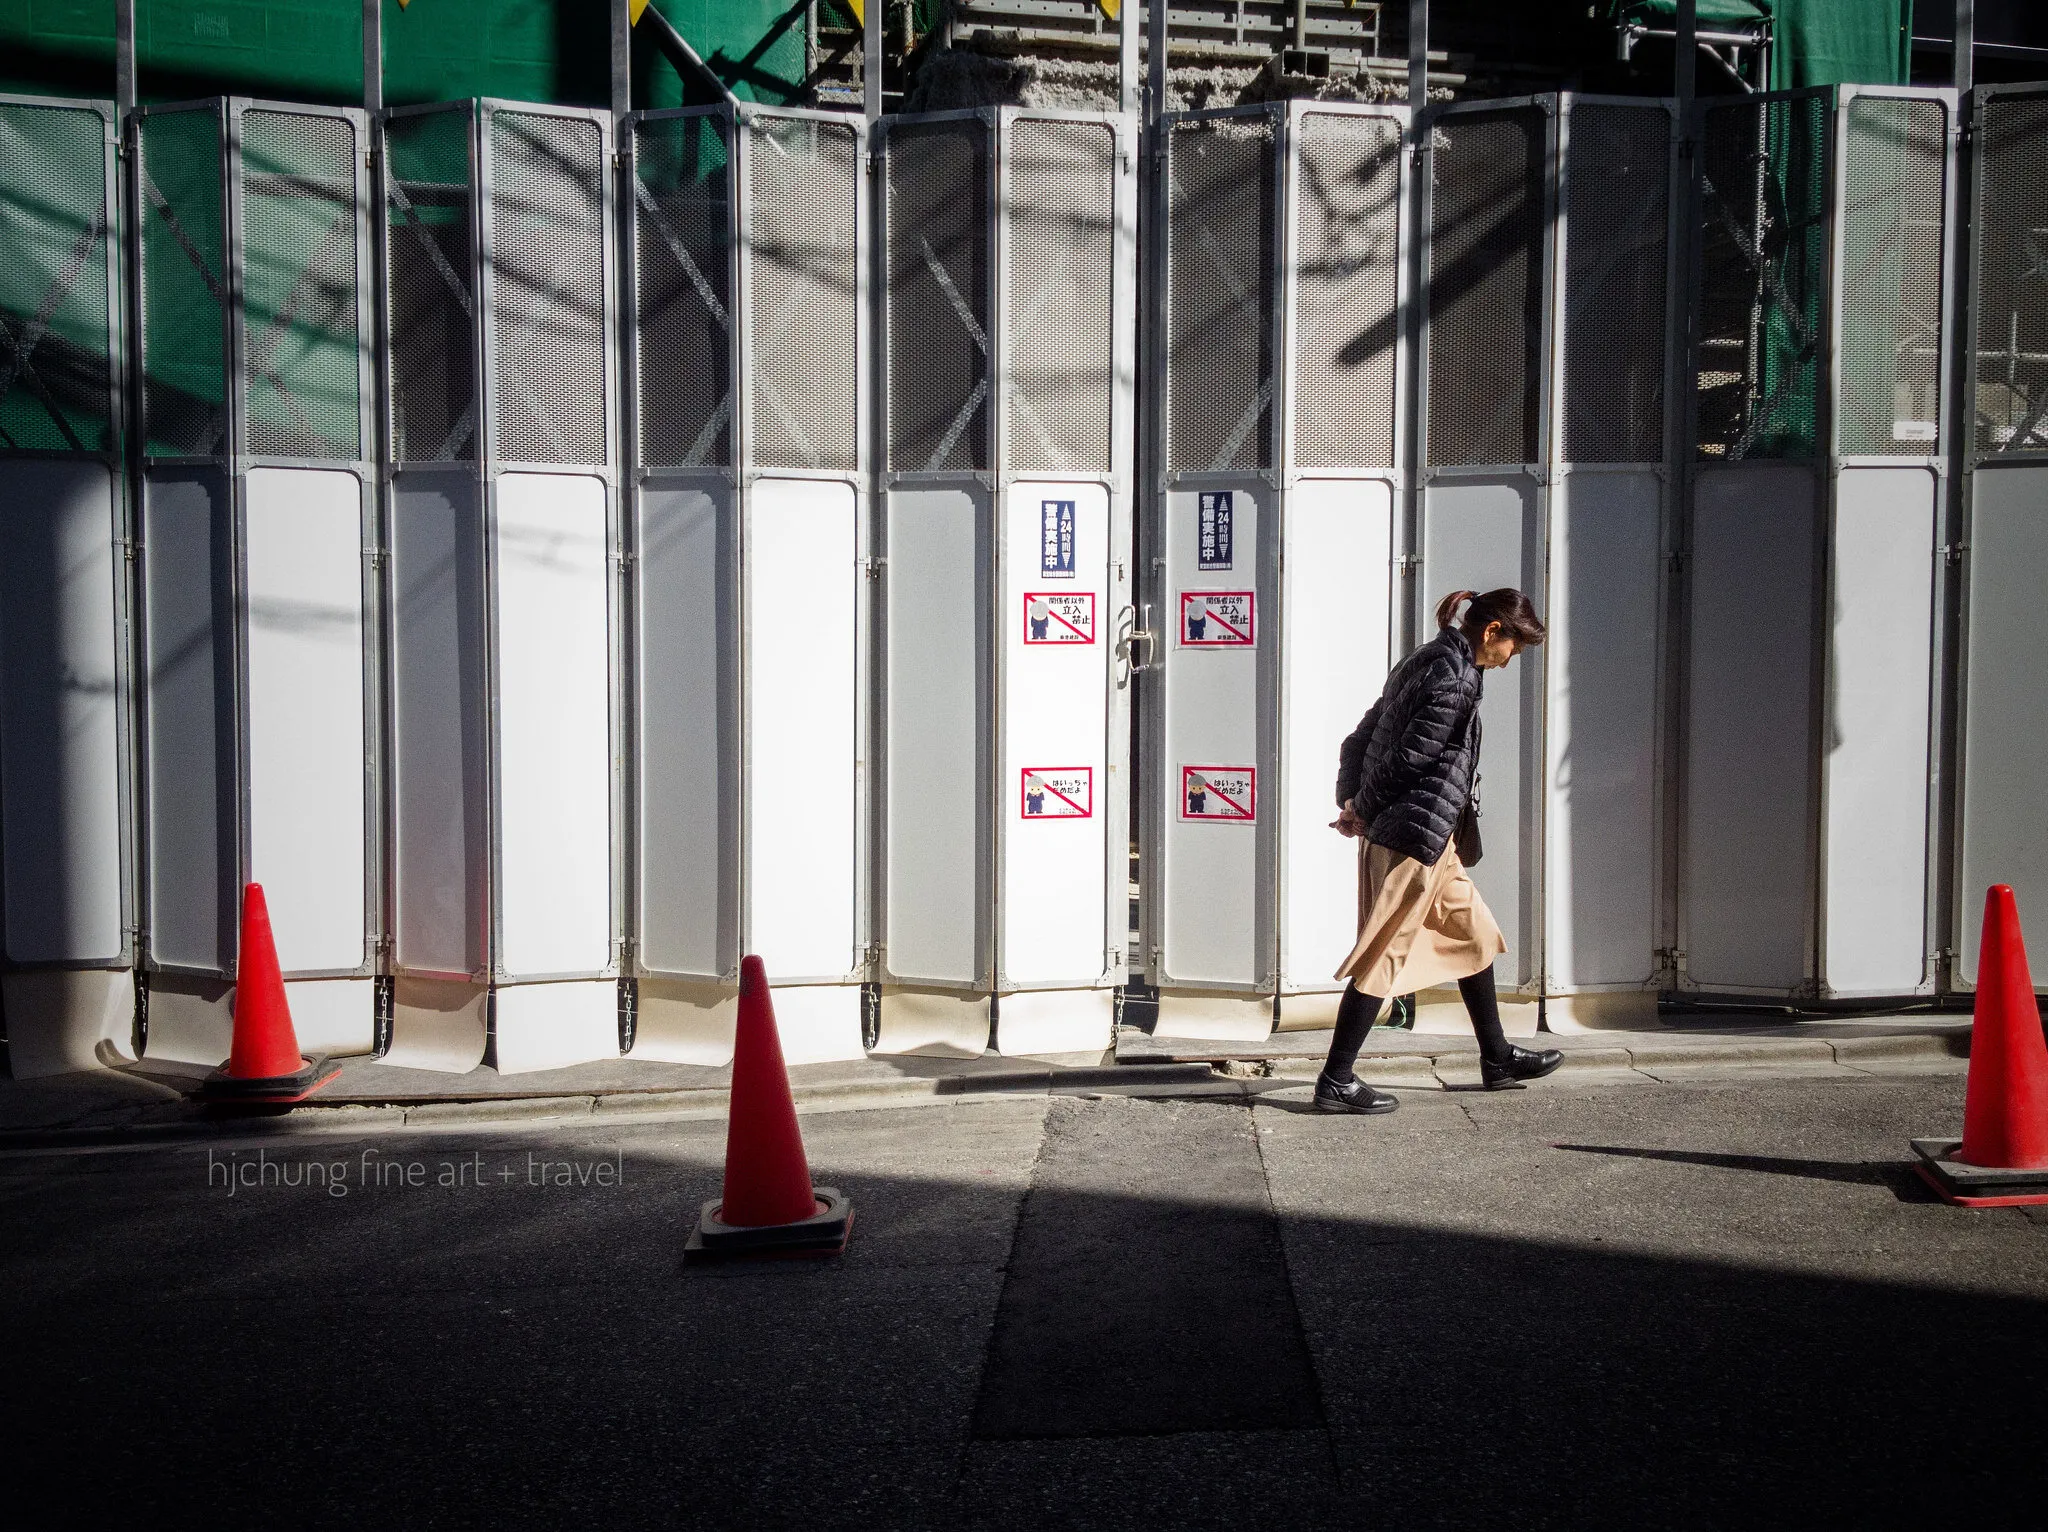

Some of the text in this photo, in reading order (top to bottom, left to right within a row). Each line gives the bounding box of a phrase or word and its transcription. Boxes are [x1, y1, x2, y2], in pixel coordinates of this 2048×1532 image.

[1202, 495, 1215, 561] 警備実施中
[1045, 503, 1058, 569] 警備実施中
[1049, 597, 1085, 605] 関係者以外
[1206, 596, 1244, 605] 関係者以外
[1062, 605, 1082, 615] 立入
[1219, 605, 1240, 615] 立入
[1072, 615, 1091, 625] 禁止
[1229, 615, 1249, 625] 禁止
[1052, 779, 1088, 787] はいっちゃ
[1213, 779, 1251, 787] はいっちゃ
